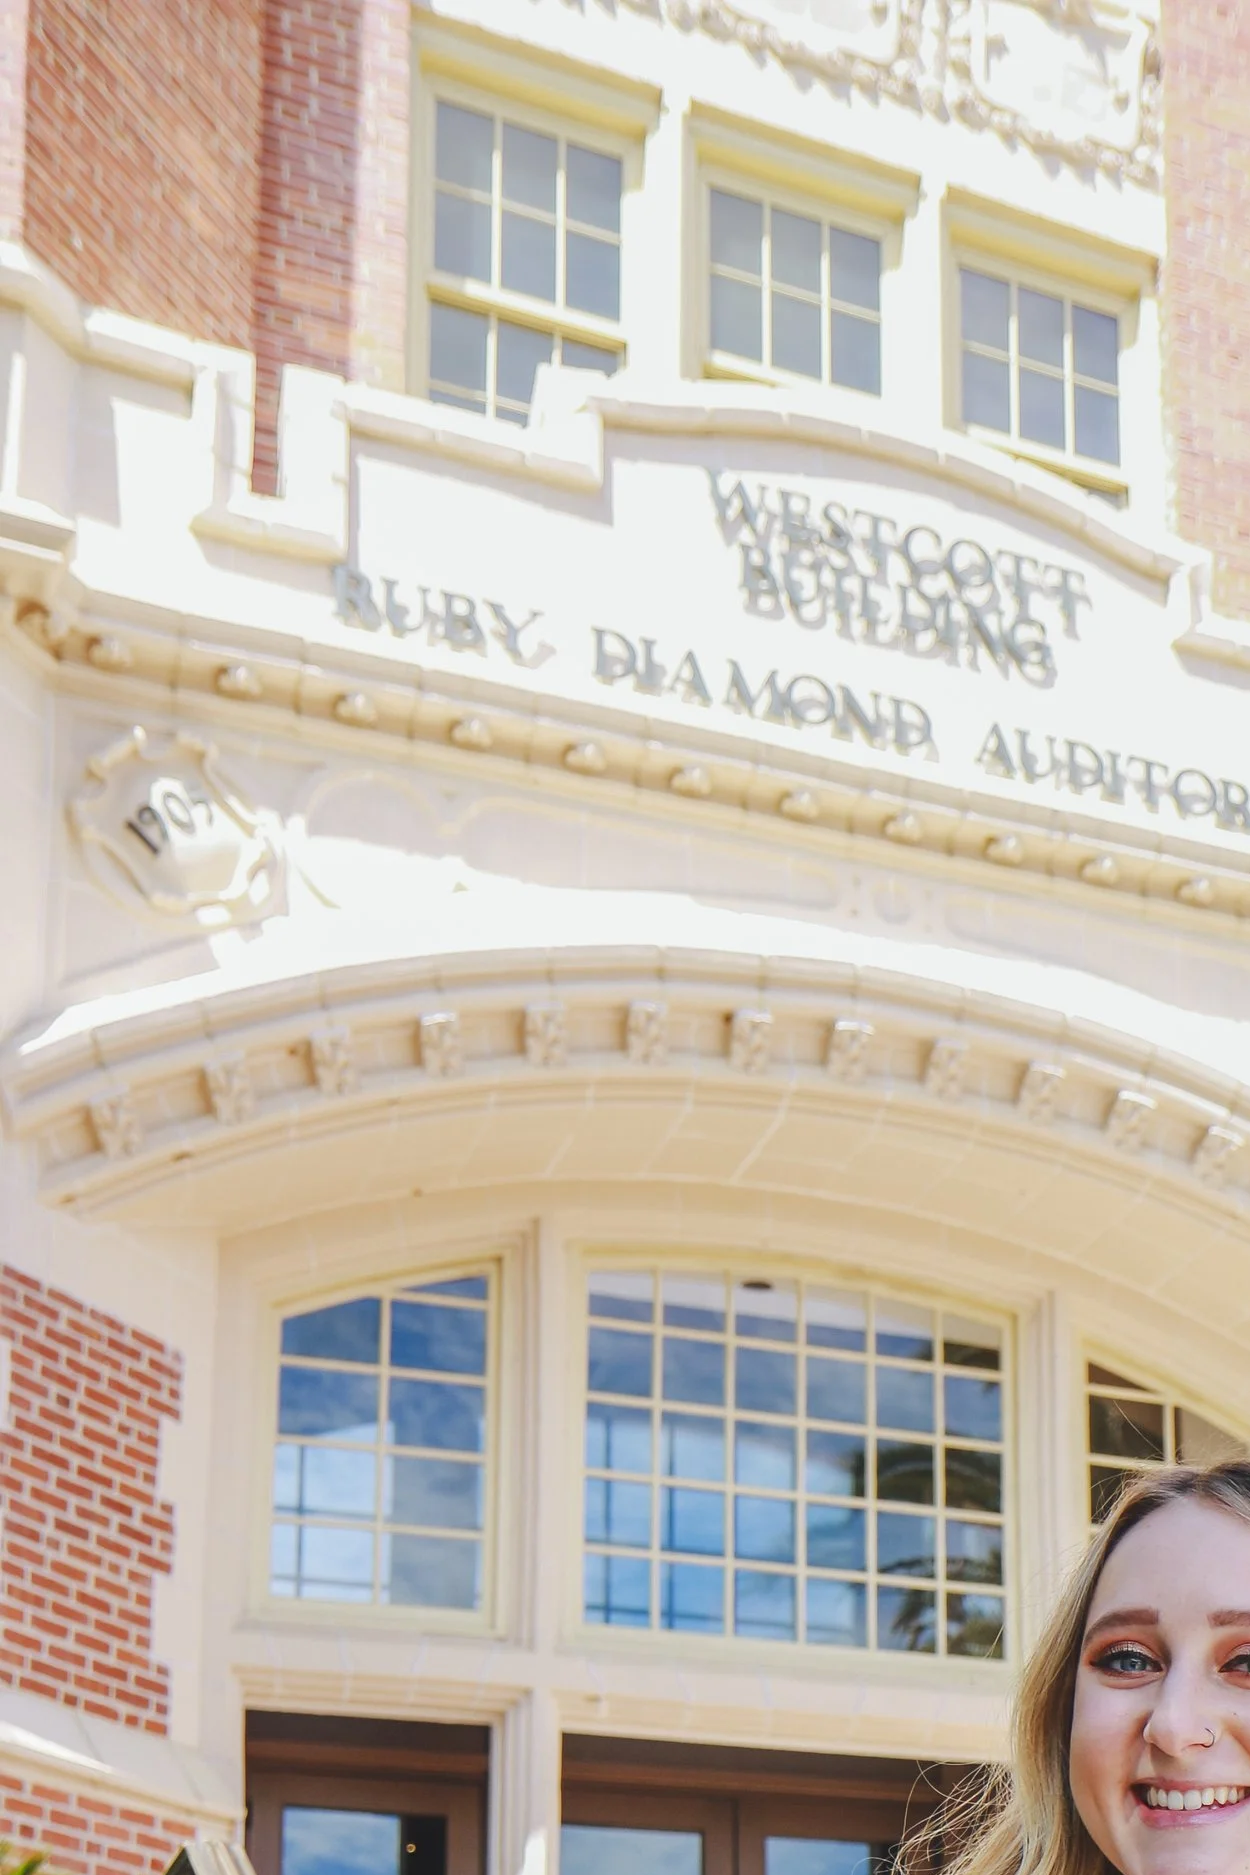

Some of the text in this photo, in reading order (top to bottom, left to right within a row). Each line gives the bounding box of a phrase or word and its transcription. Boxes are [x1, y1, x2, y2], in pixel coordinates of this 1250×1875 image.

[704, 467, 1089, 632] WESTCOTT
[740, 545, 1053, 676] BUILDING
[333, 563, 547, 660] RUBY
[591, 626, 934, 752] DIAMOND
